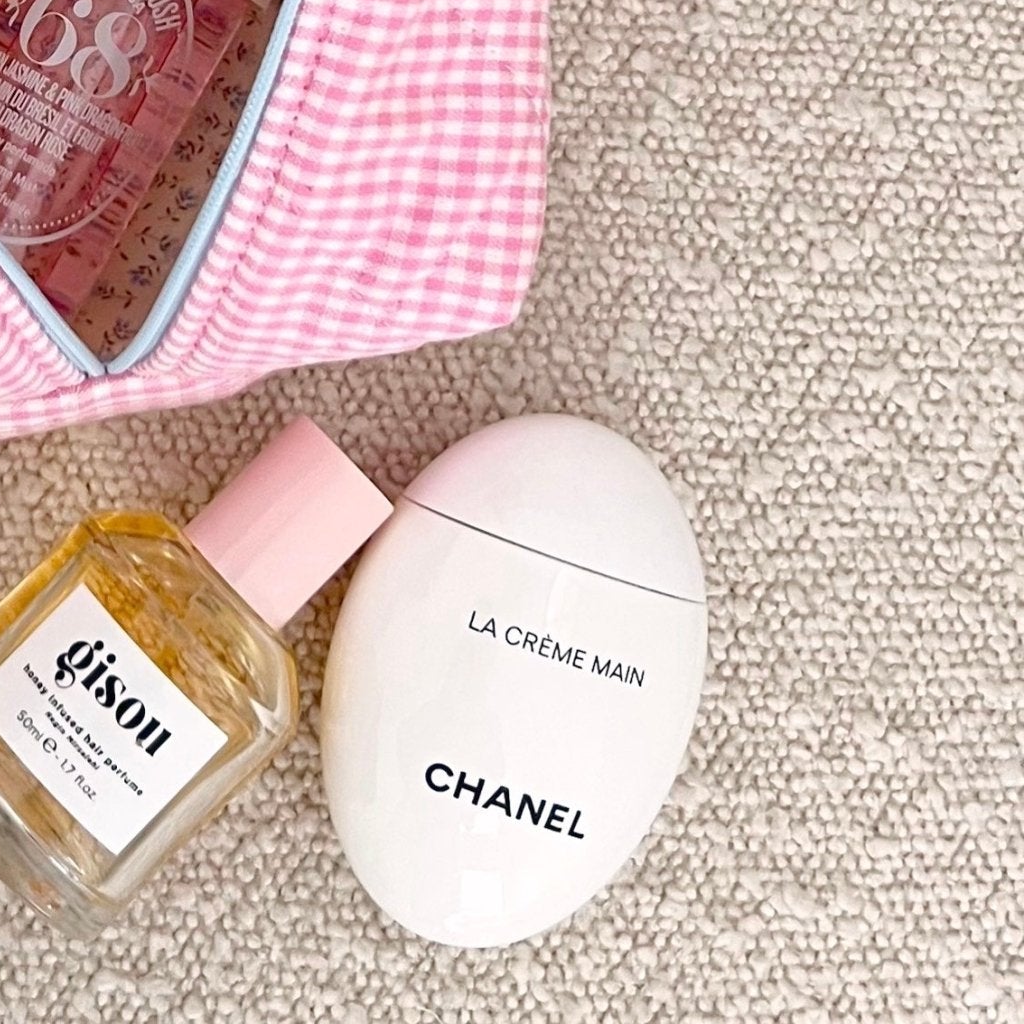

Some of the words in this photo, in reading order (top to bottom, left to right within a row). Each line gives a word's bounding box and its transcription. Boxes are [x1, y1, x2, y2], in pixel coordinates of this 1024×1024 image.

[3, 59, 47, 95] JASMINE
[45, 83, 59, 102] &
[0, 107, 45, 146] DRAGON
[40, 130, 73, 162] ROSE
[11, 89, 29, 110] DU
[73, 125, 105, 155] FRUIT
[468, 610, 497, 638] LA
[504, 625, 587, 669] CRÈME
[591, 655, 645, 687] MAIN
[17, 709, 44, 741] 50ml
[23, 663, 48, 695] honey
[48, 694, 84, 735] infused
[84, 733, 104, 756] hair
[104, 757, 143, 796] perfume
[54, 640, 172, 757] gisou
[424, 762, 585, 839] CHANEL
